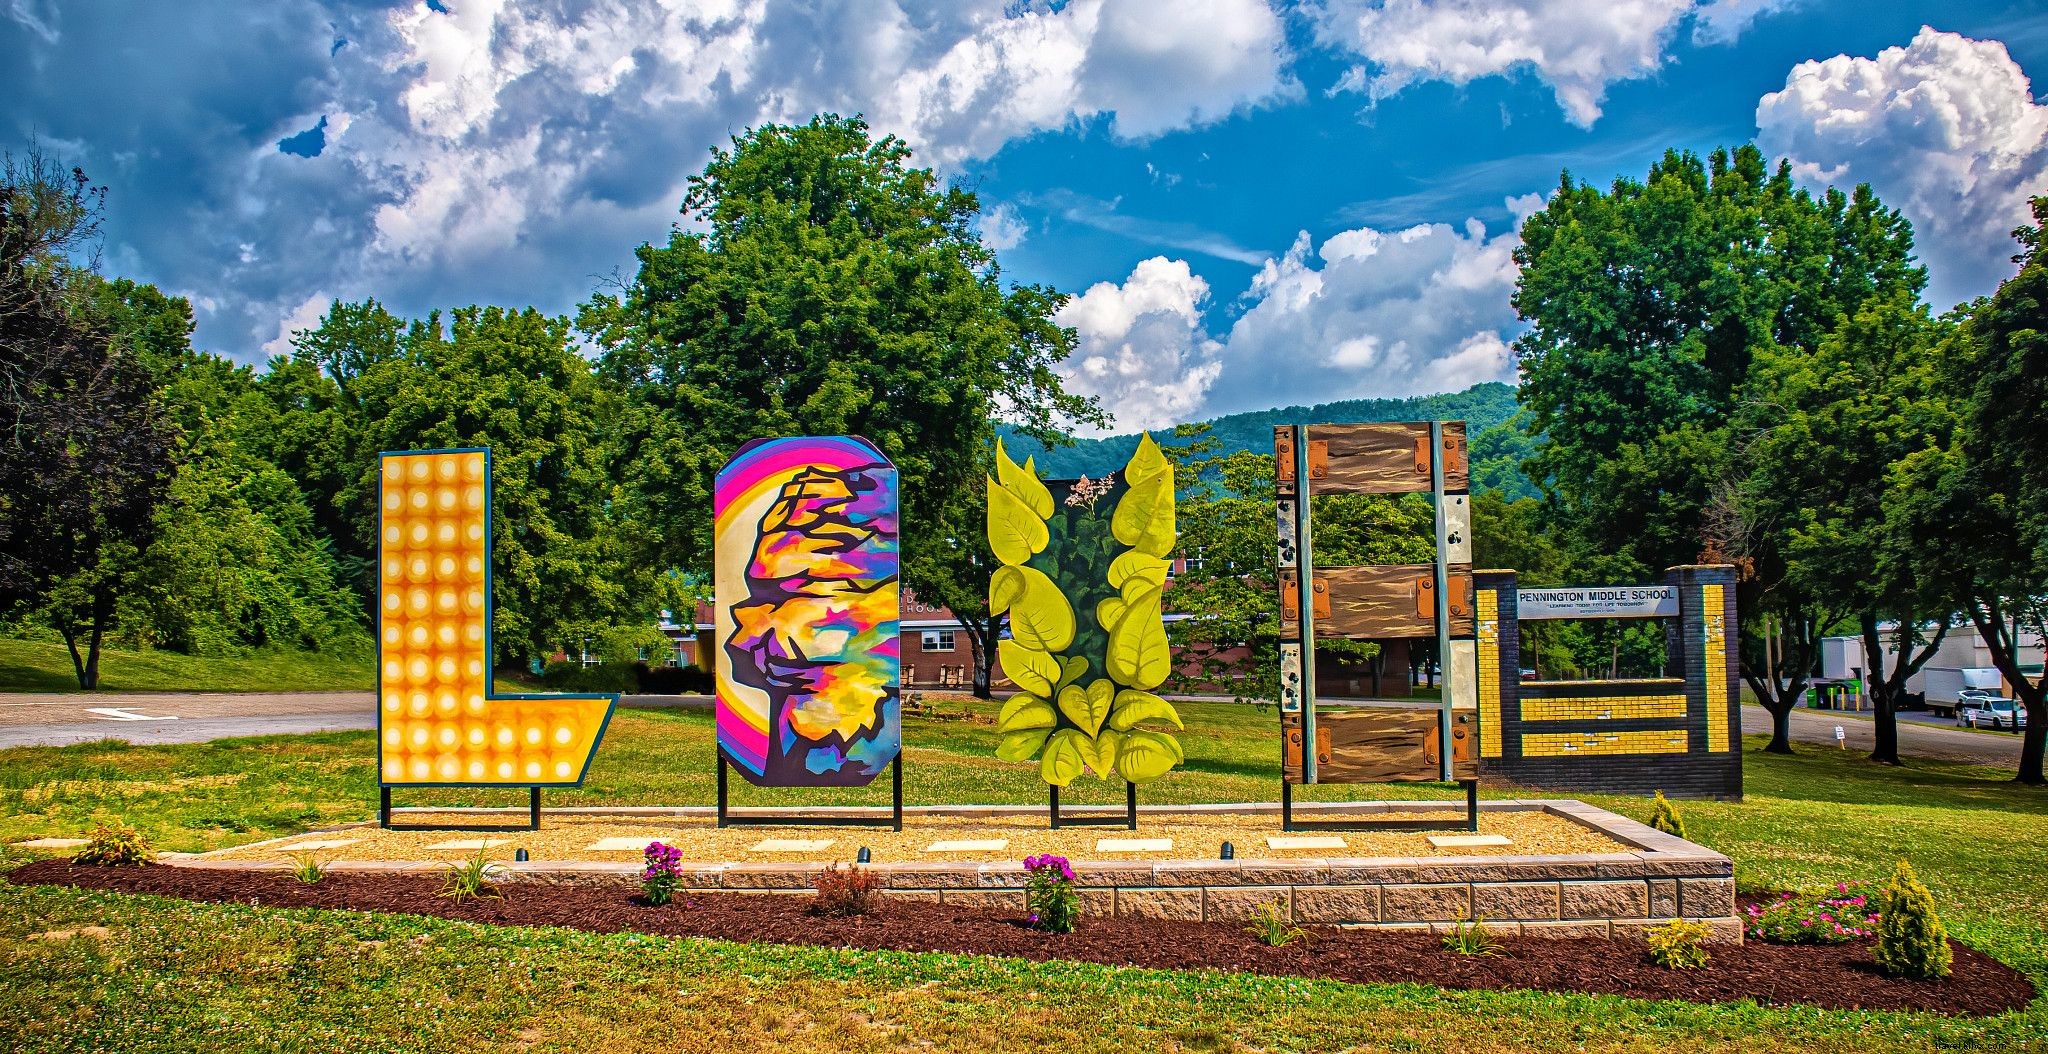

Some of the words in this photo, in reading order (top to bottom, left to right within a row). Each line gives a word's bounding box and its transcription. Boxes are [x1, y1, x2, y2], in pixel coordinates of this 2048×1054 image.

[1519, 592, 1583, 602] PENNINGTON
[1588, 591, 1627, 600] MIDDLE
[1631, 590, 1674, 600] SCHOOL
